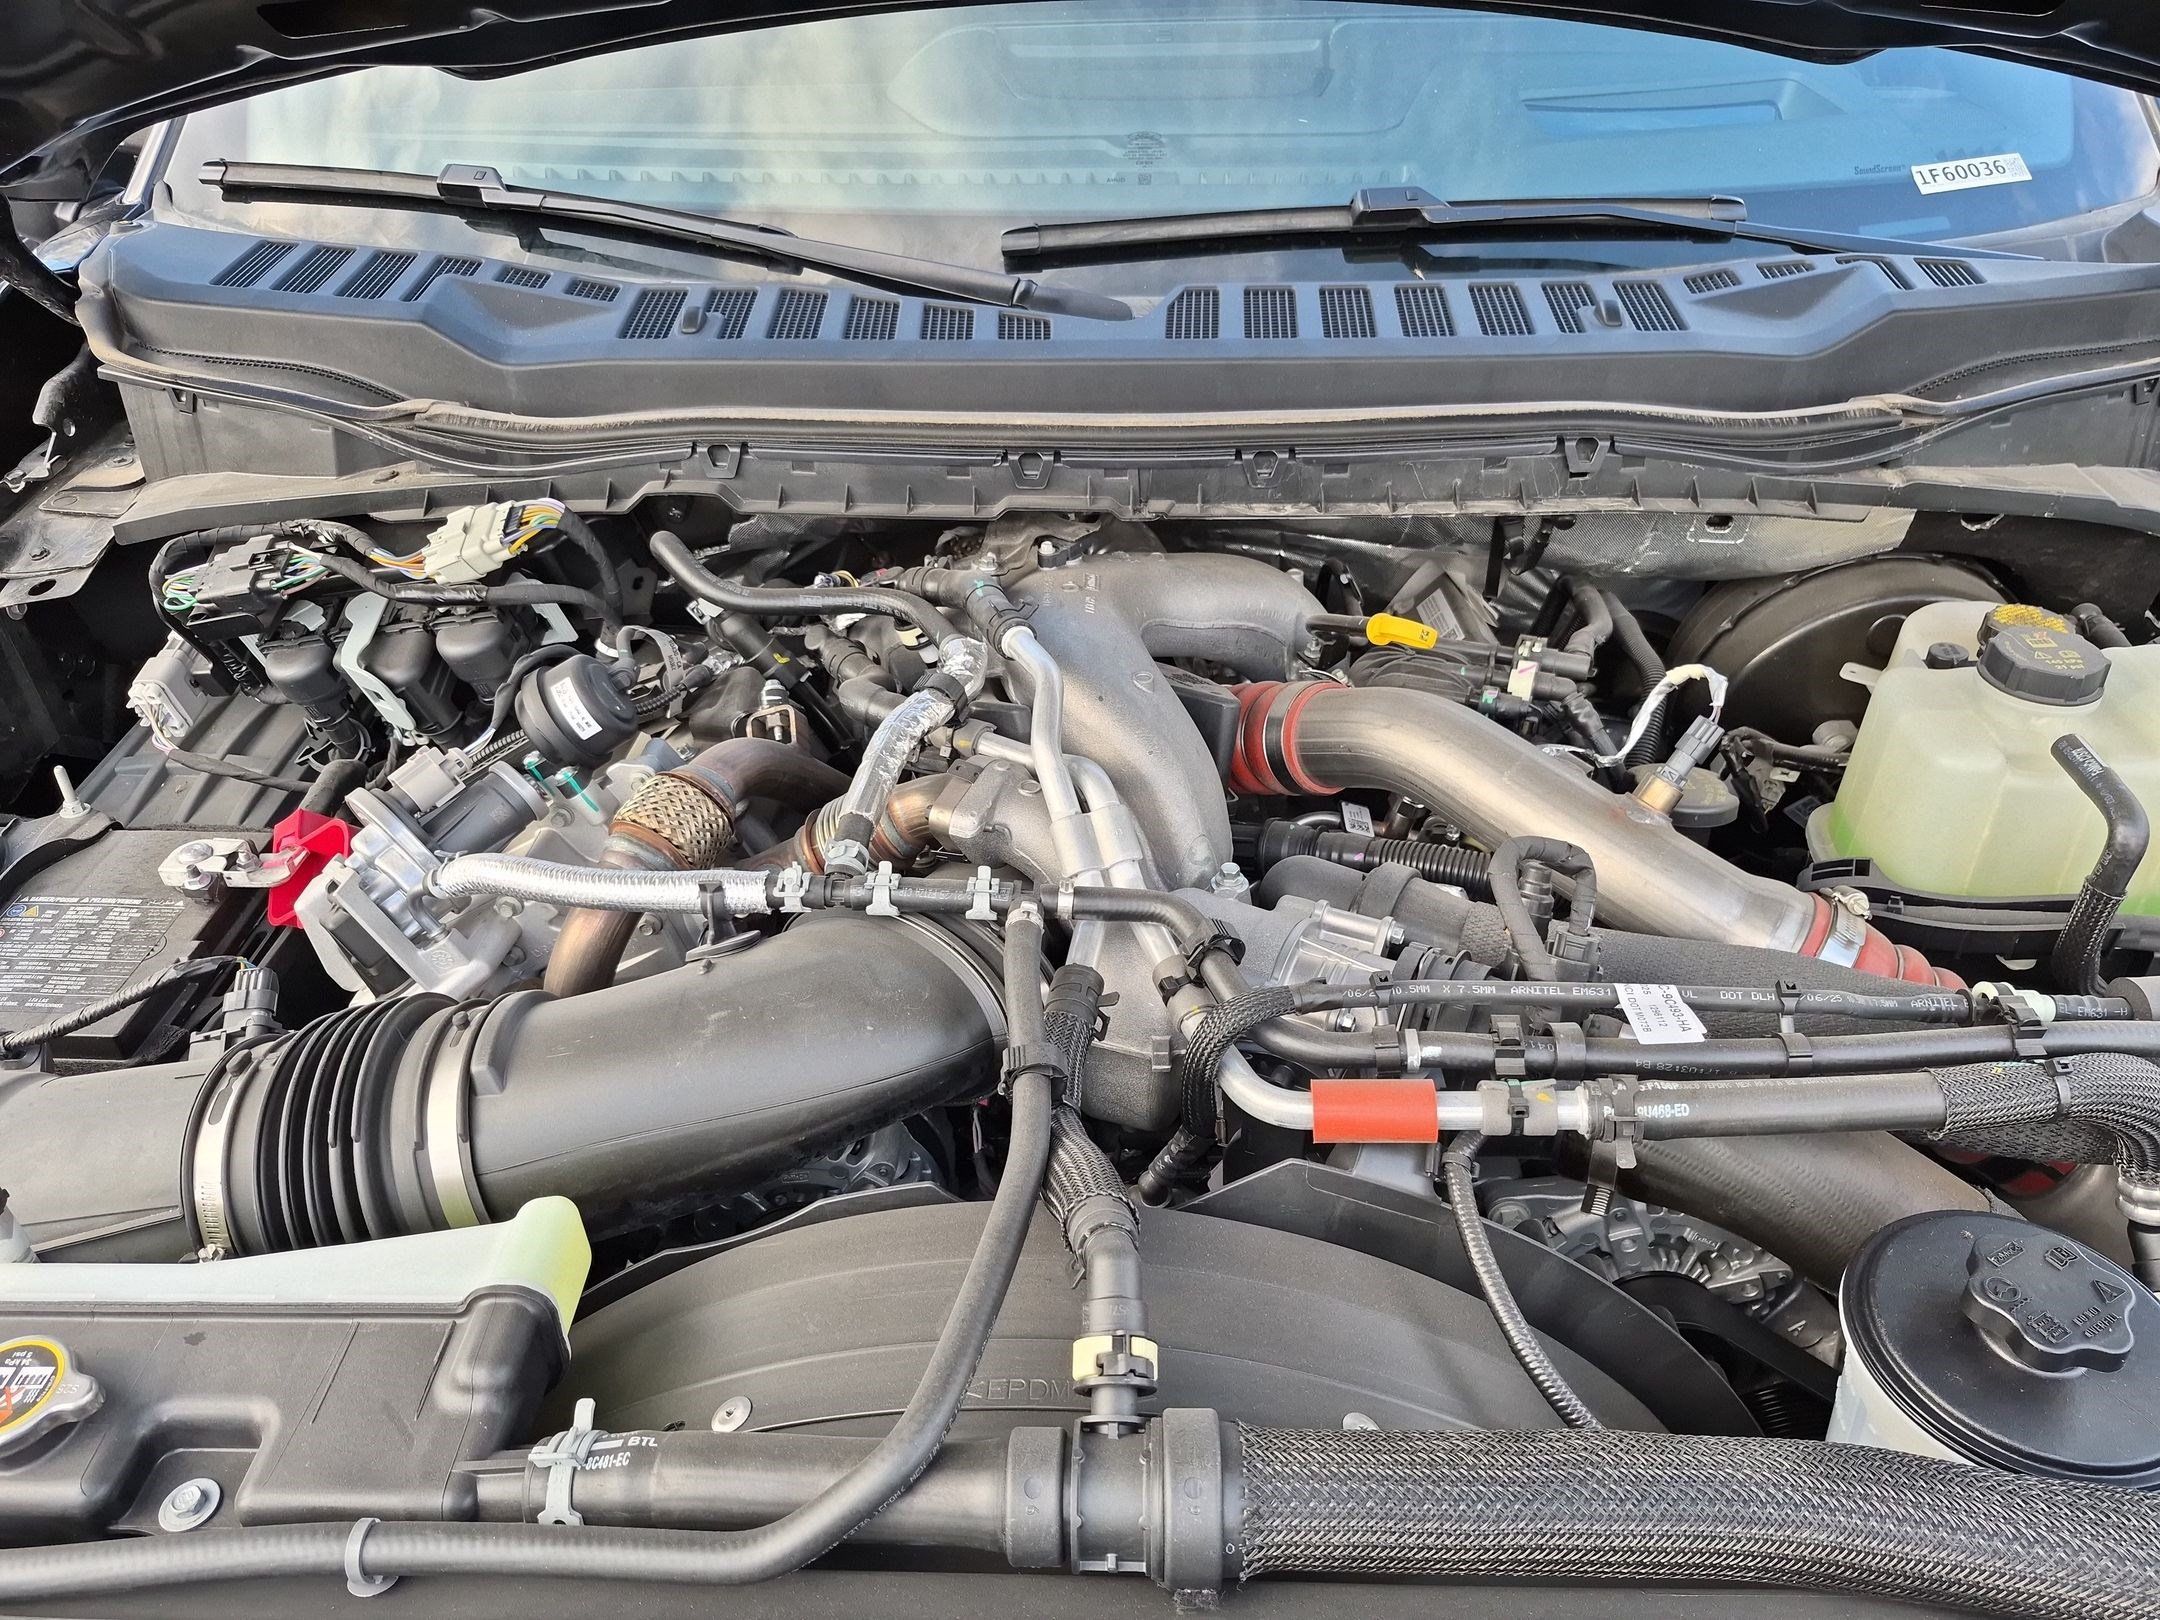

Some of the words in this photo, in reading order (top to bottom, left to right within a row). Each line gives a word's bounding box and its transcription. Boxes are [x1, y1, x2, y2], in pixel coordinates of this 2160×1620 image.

[1915, 159, 2006, 185] 1F60036
[1442, 983, 1451, 993] X
[1457, 984, 1497, 995] 7.5MM
[1510, 985, 1566, 996] ARNITEL
[1572, 986, 1612, 997] EM631
[1720, 990, 1743, 1000] DOT
[1628, 997, 1642, 1011] DOT
[2084, 1312, 2122, 1338] OVERFILL
[627, 1436, 658, 1447] BTL
